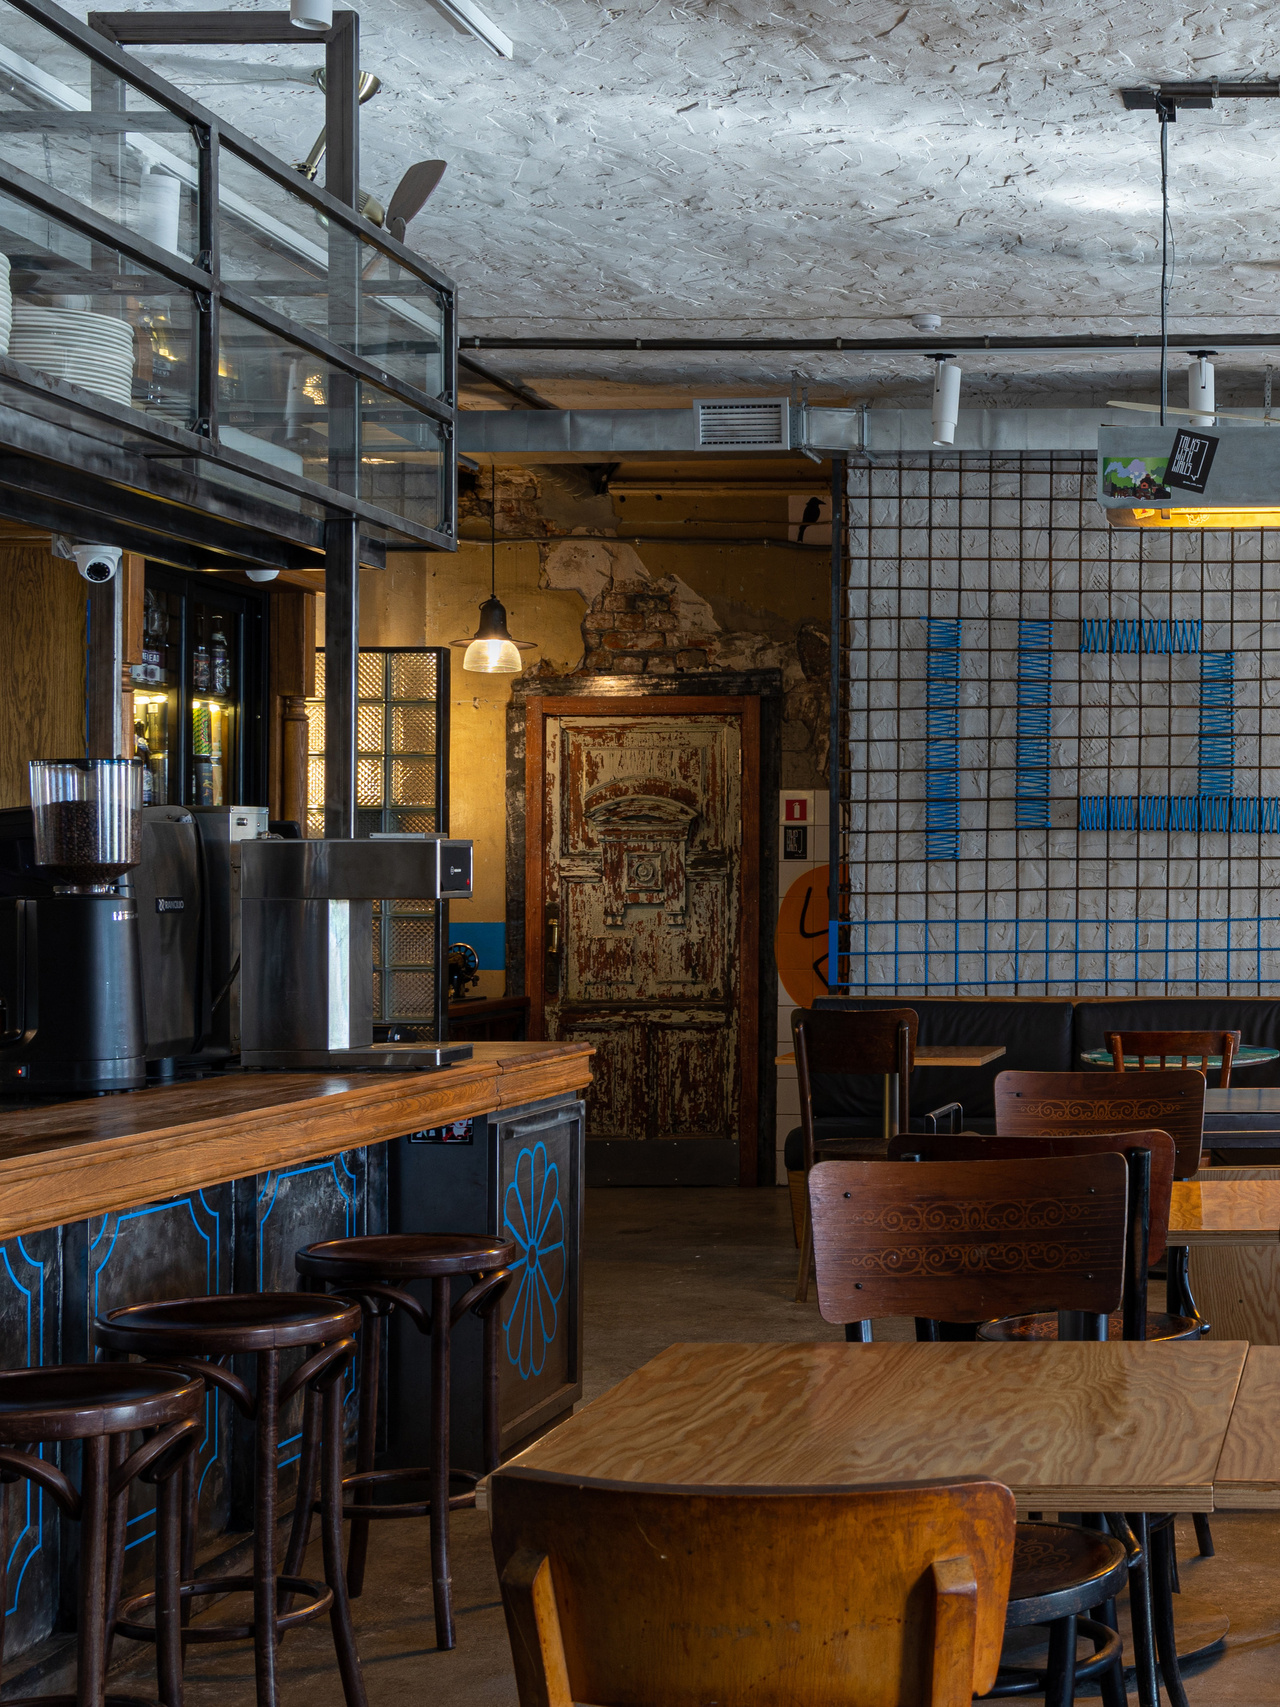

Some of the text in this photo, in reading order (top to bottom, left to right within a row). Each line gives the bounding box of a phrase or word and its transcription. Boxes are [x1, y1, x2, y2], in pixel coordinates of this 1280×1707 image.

[1178, 434, 1201, 452] TALKS
[1174, 447, 1194, 463] WITH
[1171, 459, 1193, 476] WALLS
